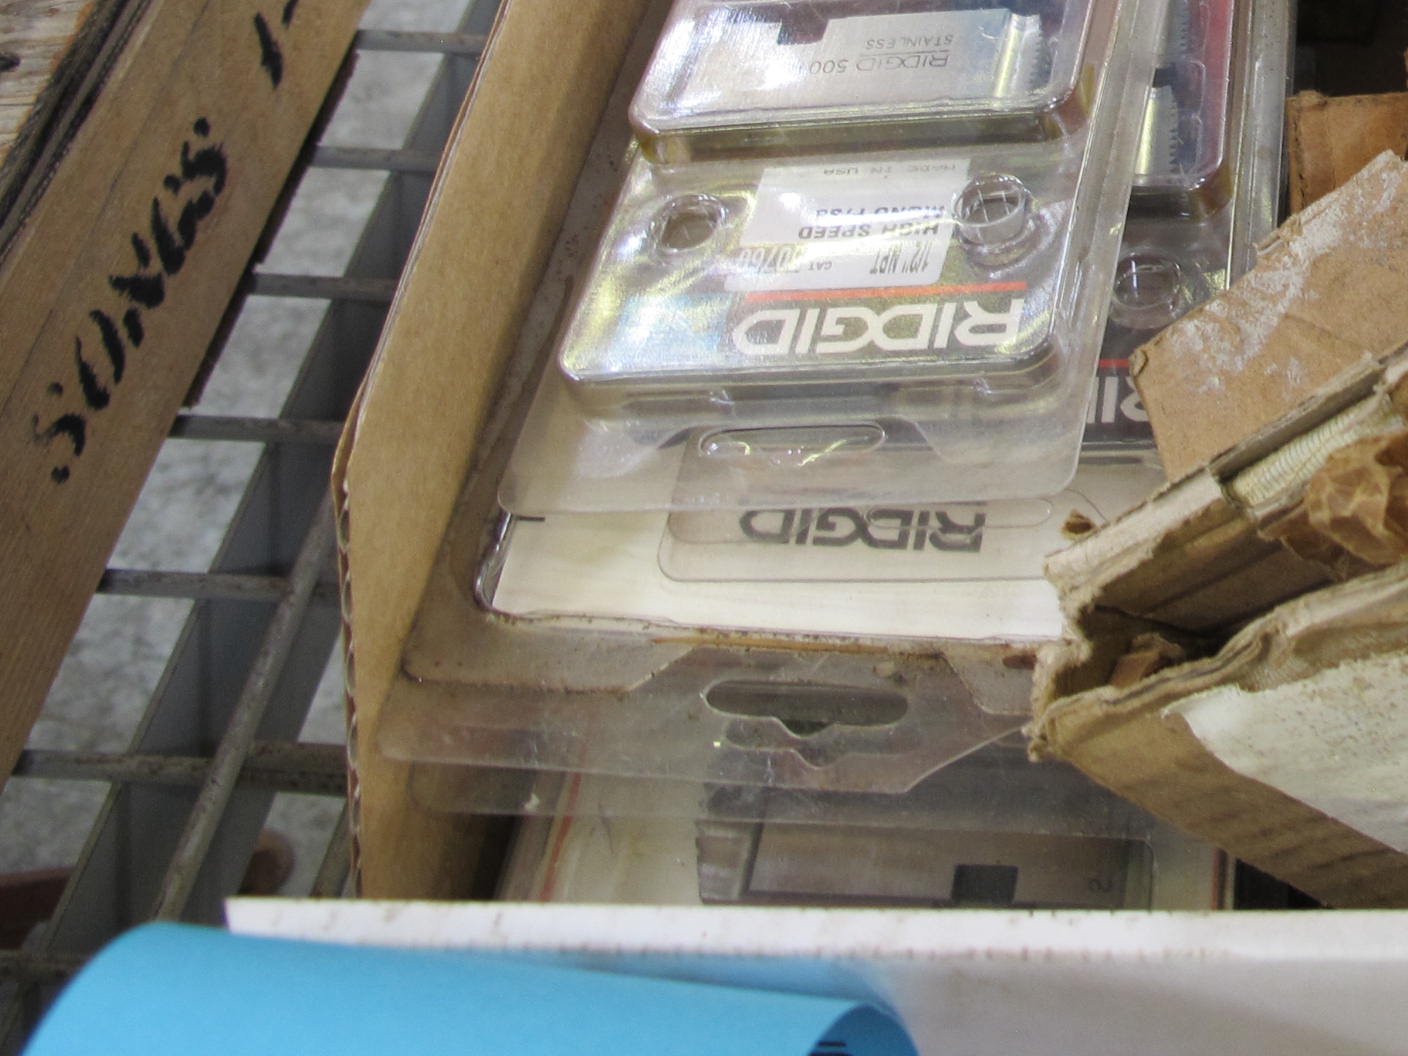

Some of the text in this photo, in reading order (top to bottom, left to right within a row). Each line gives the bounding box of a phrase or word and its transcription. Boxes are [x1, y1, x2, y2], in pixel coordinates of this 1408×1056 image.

[866, 34, 954, 51] STAINLESS
[809, 54, 950, 74] RIDGID 500
[822, 166, 861, 177] USA
[798, 222, 940, 241] HIGH SPEED
[869, 248, 900, 275] NPT
[732, 298, 1025, 356] RIDGID
[739, 506, 987, 554] RIDGID
